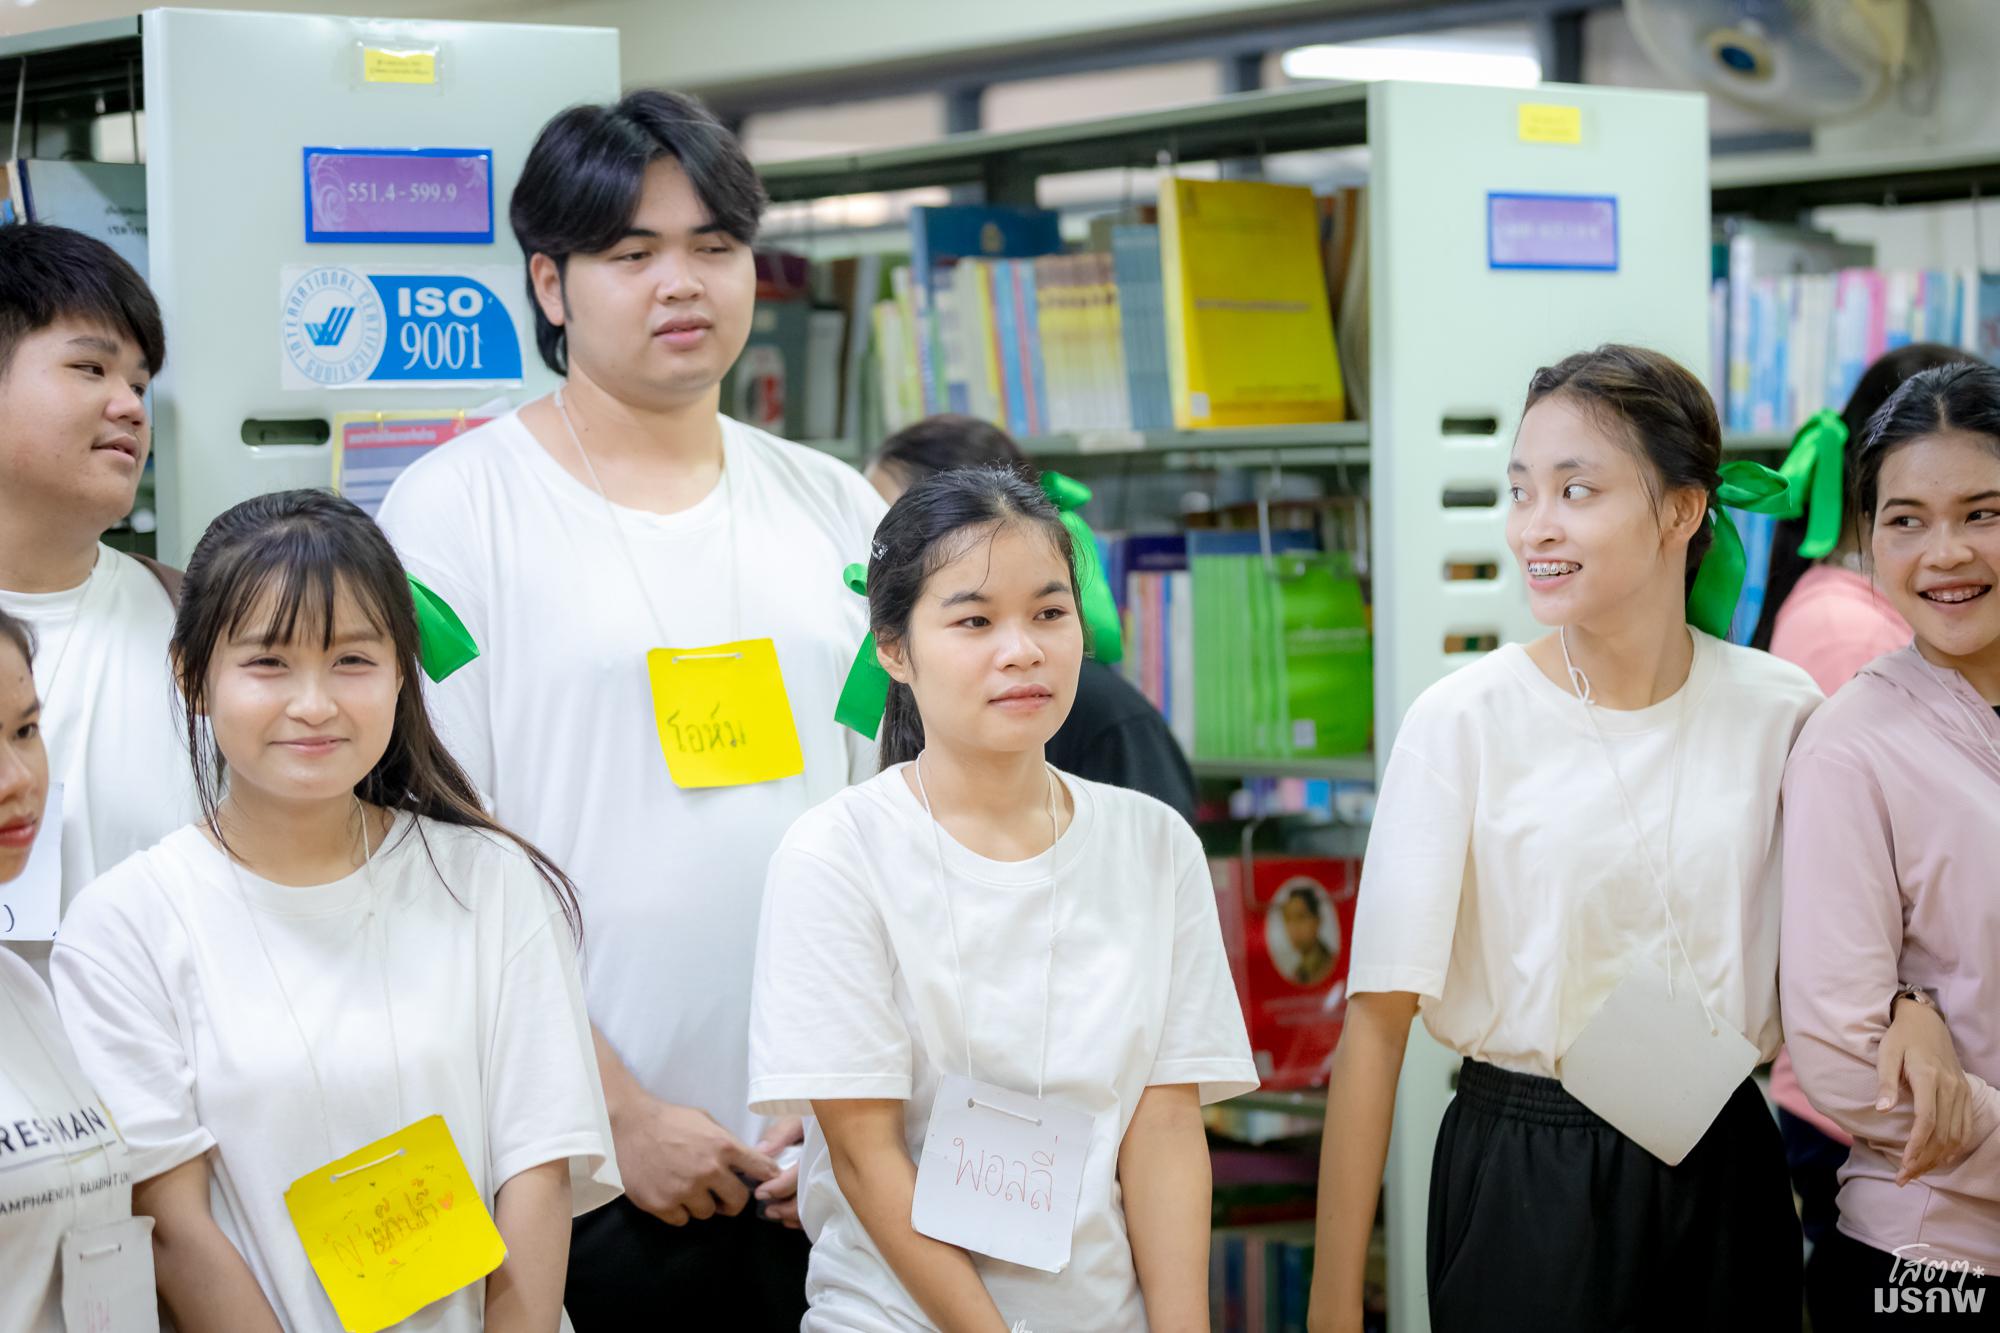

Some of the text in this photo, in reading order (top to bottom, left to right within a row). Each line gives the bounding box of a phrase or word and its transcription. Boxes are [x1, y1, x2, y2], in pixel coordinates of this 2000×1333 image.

[397, 286, 484, 318] ISO
[400, 321, 483, 371] 9001
[953, 1135, 1060, 1213] พอลลี่
